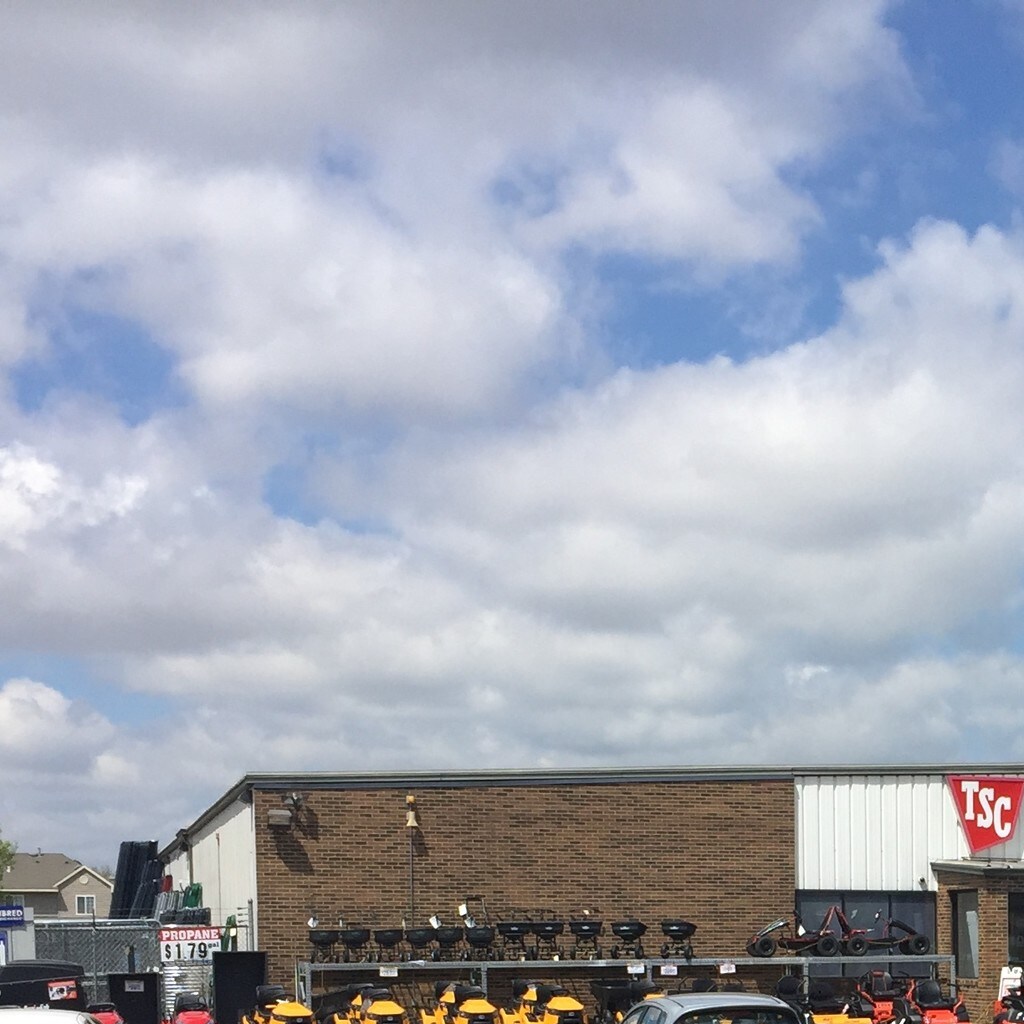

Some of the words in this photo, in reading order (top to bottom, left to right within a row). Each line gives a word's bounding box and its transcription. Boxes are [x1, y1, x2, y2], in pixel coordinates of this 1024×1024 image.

[961, 780, 1012, 838] TSC
[0, 909, 23, 917] BRED
[162, 929, 219, 940] PROPANE
